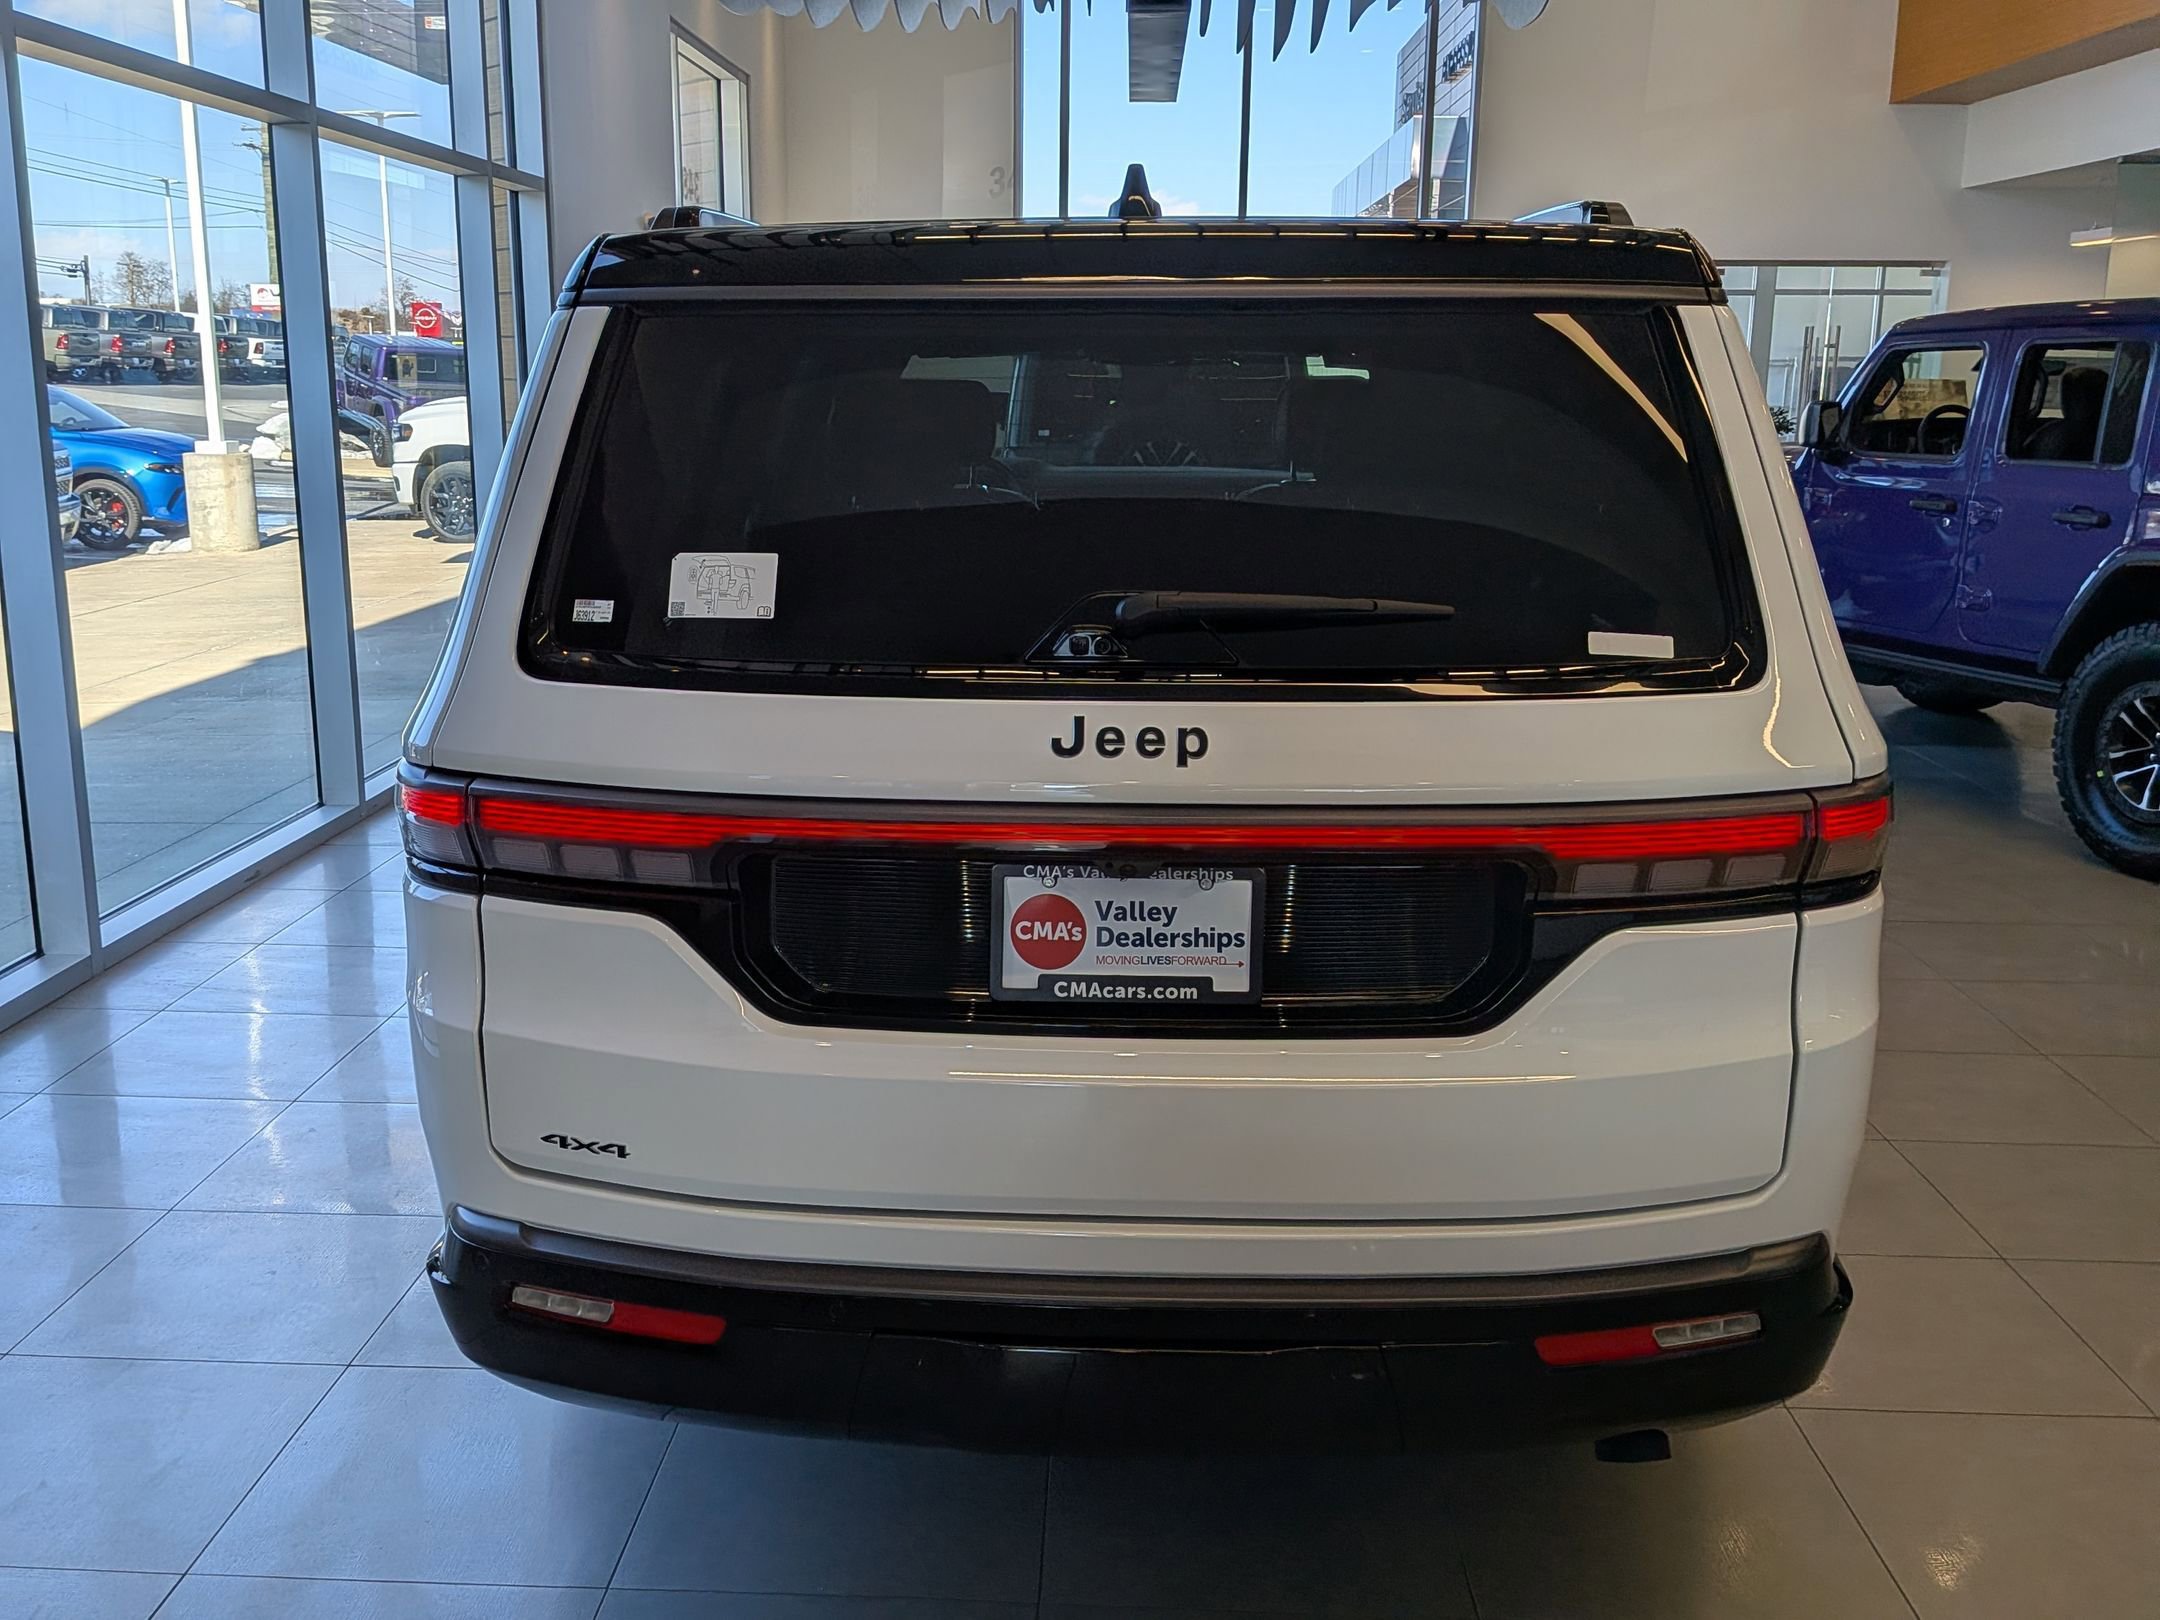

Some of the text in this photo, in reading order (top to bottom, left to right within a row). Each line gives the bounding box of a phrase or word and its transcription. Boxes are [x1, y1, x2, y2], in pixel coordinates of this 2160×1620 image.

[1051, 715, 1209, 768] Jeep
[1023, 865, 1074, 878] CMA's
[1149, 867, 1234, 882] ealerships
[1095, 900, 1178, 927] Valley
[1015, 921, 1083, 941] CMA's
[1096, 927, 1246, 953] Dealerships
[1053, 981, 1198, 1000] CMAcars.com
